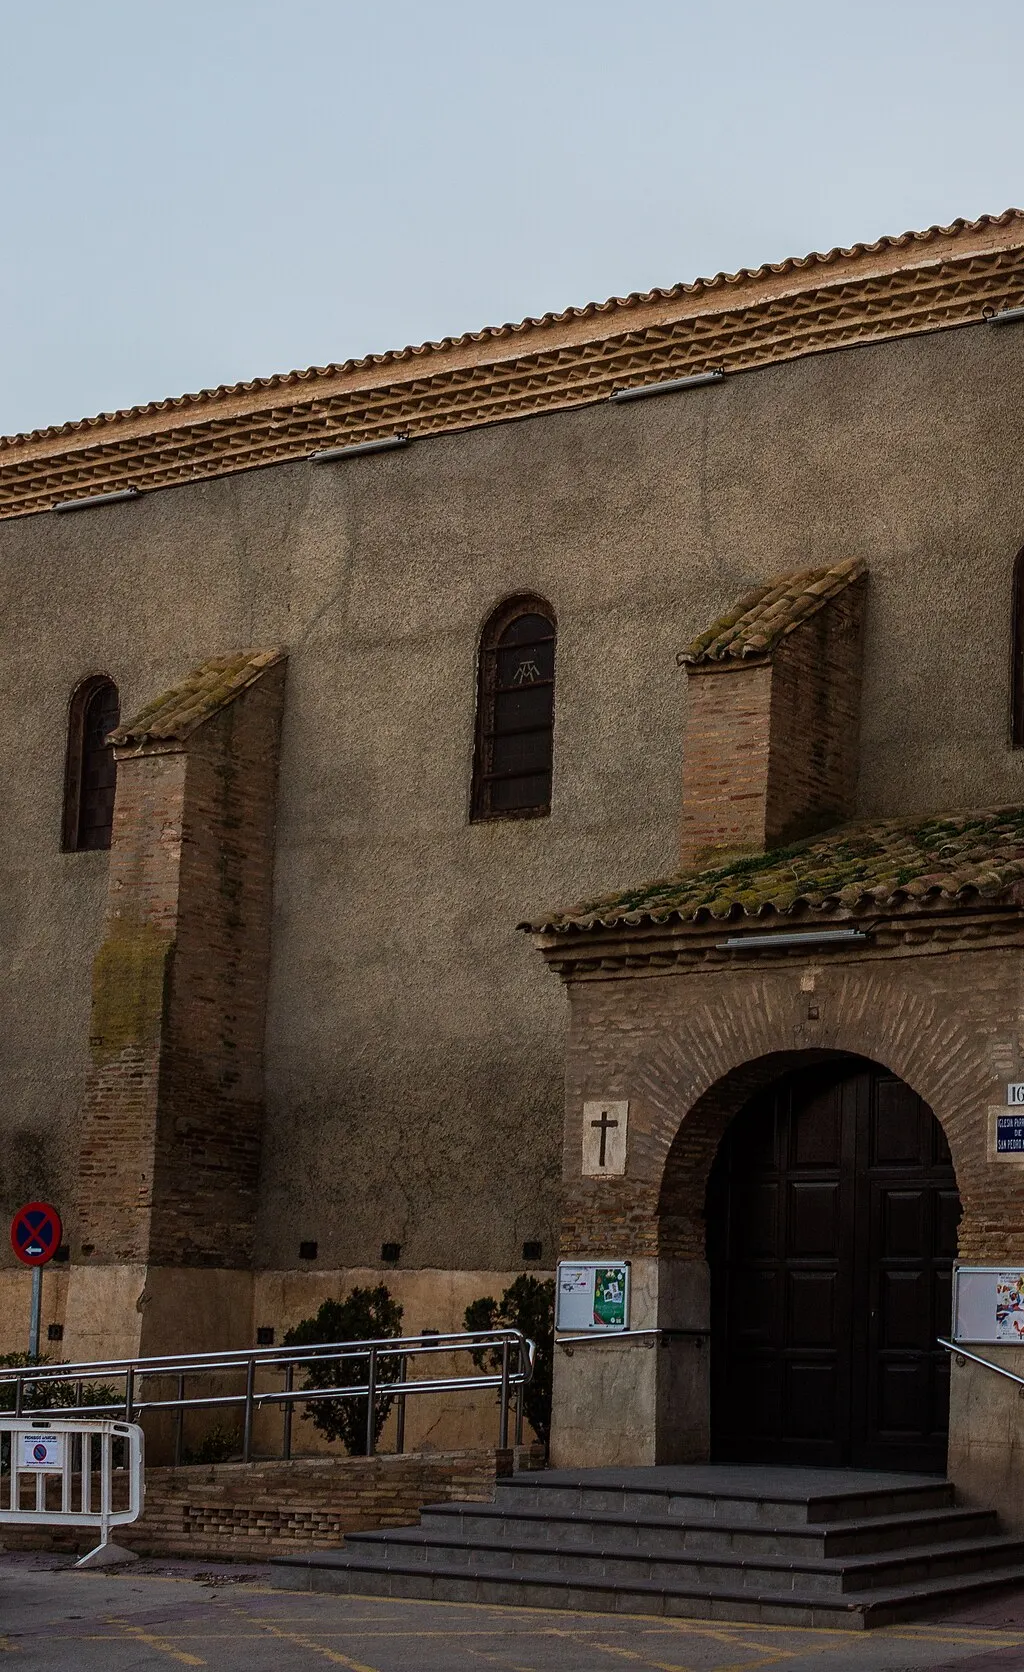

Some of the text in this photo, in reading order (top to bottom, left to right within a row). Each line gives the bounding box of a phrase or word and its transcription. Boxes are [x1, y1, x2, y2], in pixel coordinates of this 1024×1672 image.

[1012, 1086, 1024, 1102] 16
[998, 1139, 1006, 1149] SAN
[1007, 1139, 1022, 1149] PEDRO
